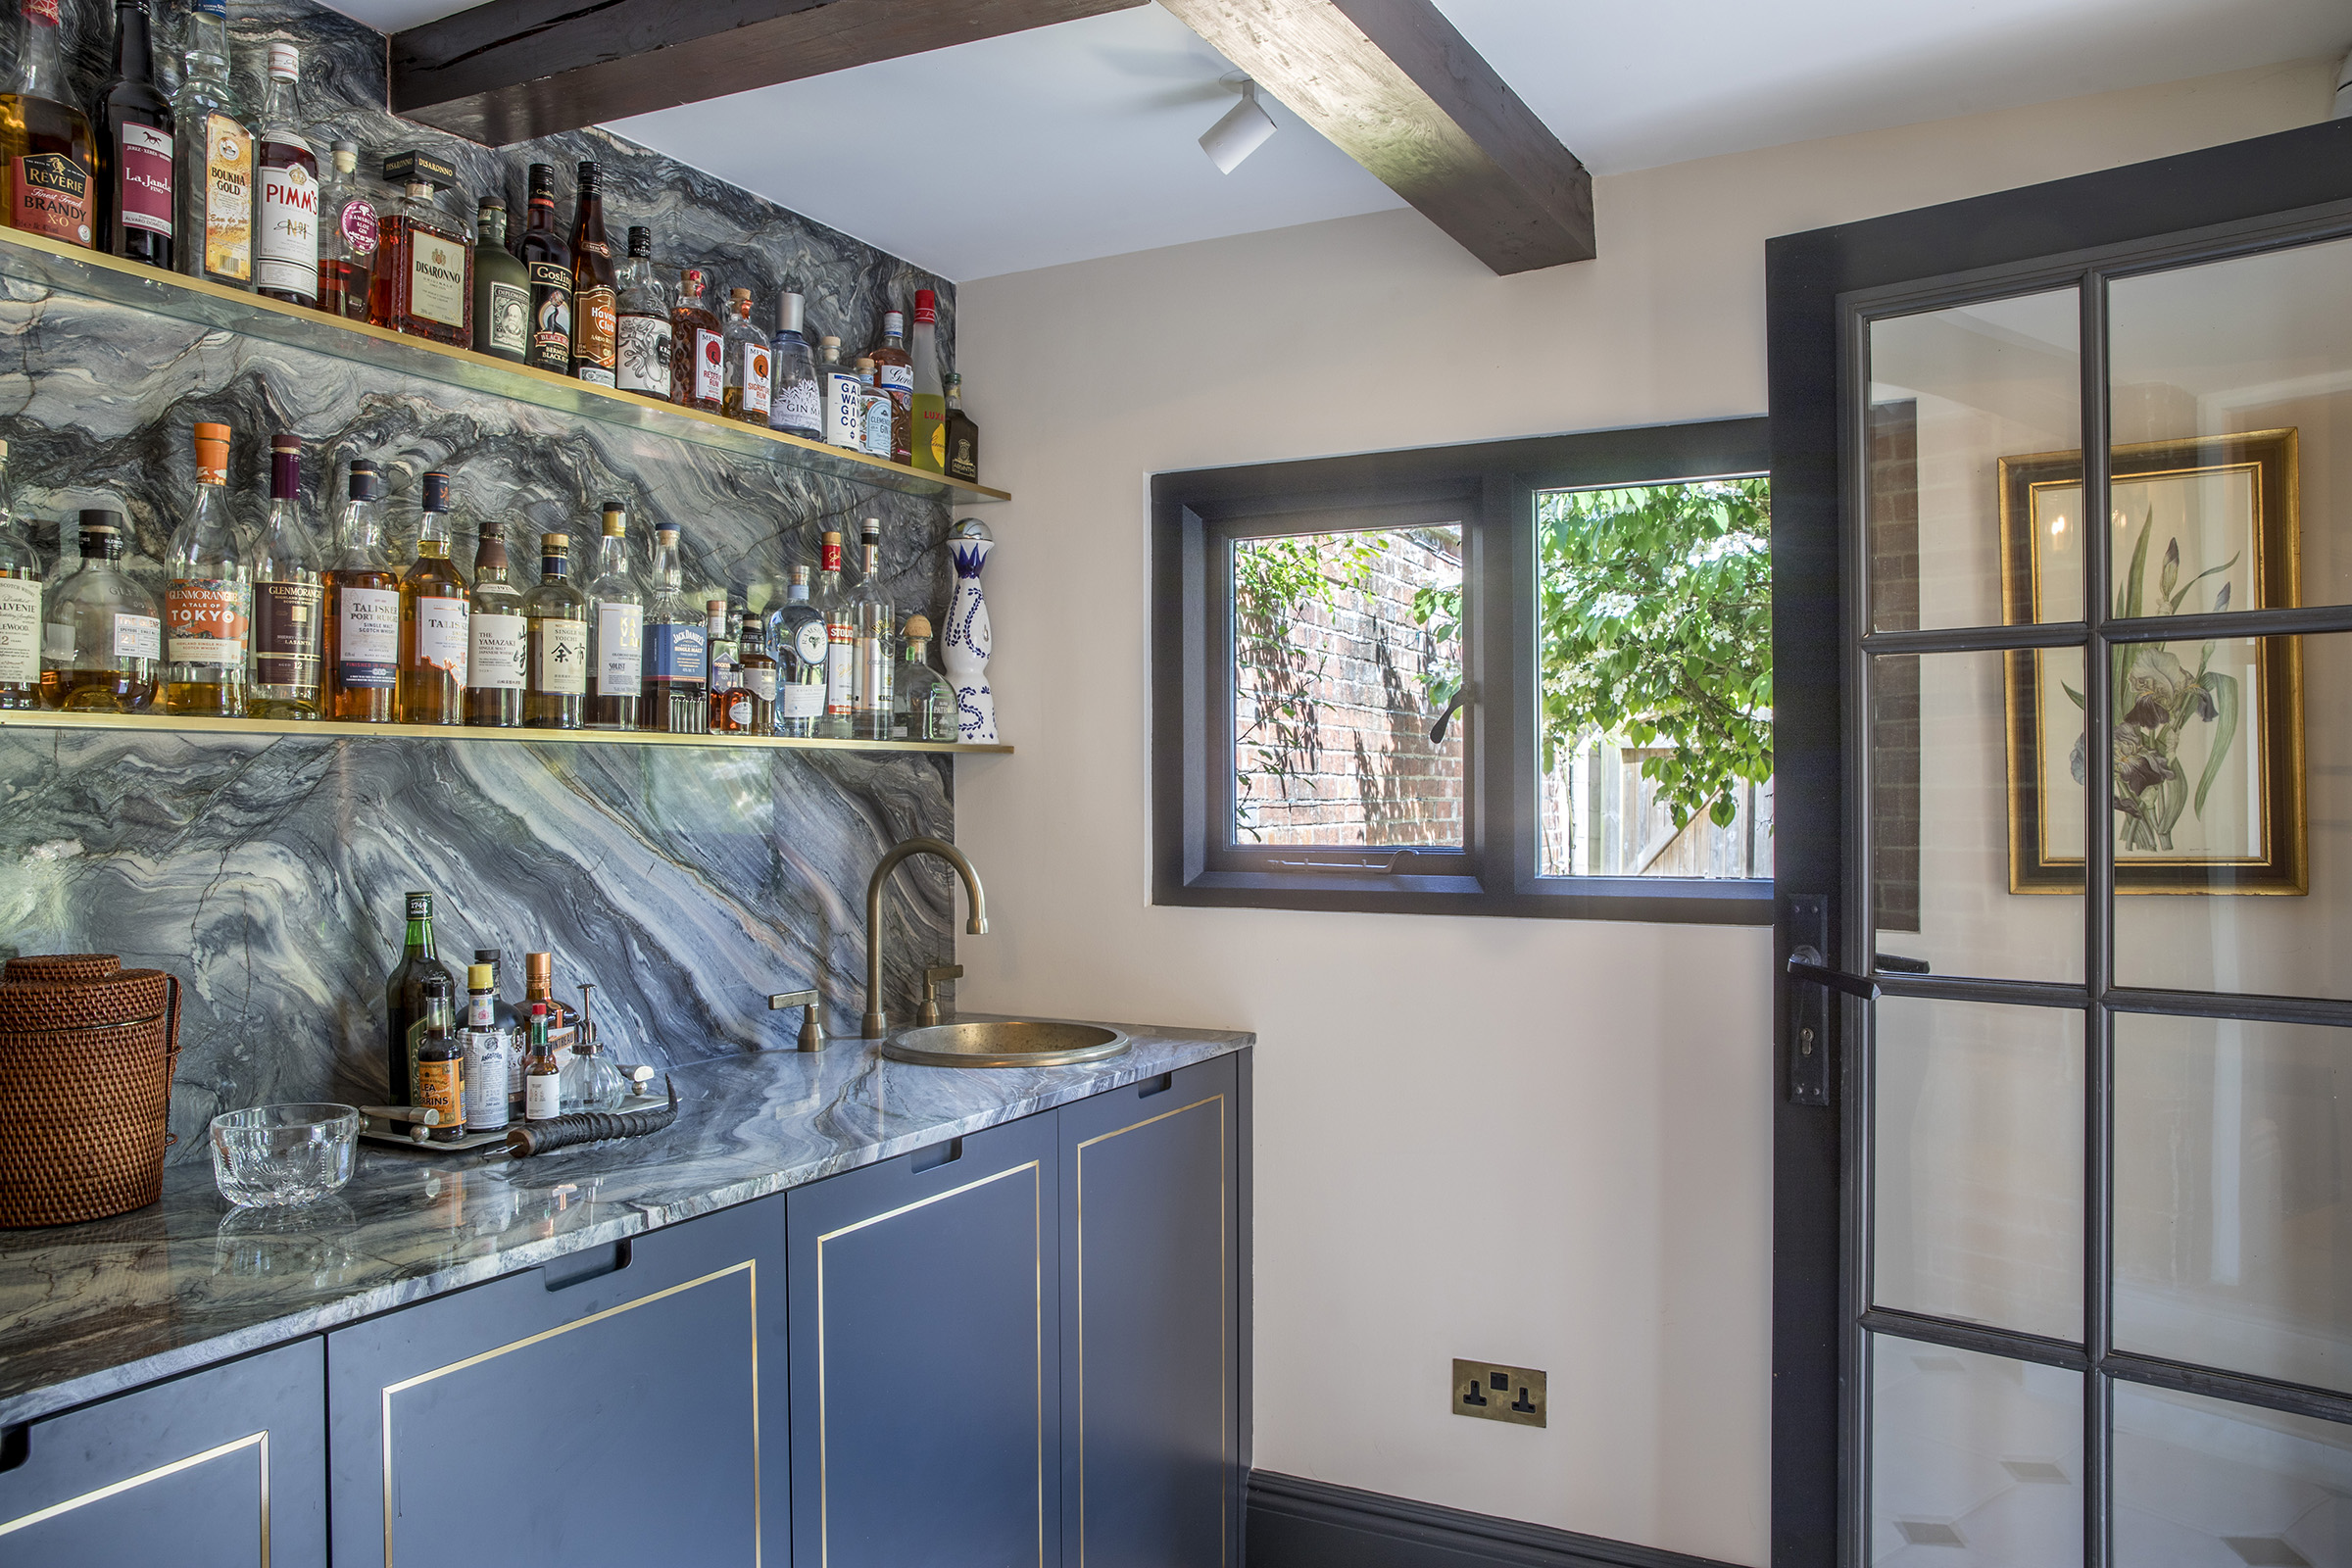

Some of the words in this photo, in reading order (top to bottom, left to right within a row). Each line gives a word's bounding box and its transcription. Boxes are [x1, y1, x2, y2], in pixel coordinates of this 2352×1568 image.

[418, 157, 454, 177] DISARONNO
[29, 168, 84, 194] RÊVERIE
[125, 167, 142, 183] La
[141, 174, 172, 193] Janda
[211, 167, 246, 187] BOUKHA
[30, 187, 59, 201] Finest
[217, 179, 241, 196] GOLD
[266, 183, 318, 216] PIMM'S
[24, 195, 87, 222] BRANDY
[416, 260, 461, 284] DISARONNO
[599, 318, 614, 333] Club
[786, 403, 808, 414] GIN
[169, 590, 238, 603] GLENMORANGIE
[119, 616, 137, 626] THE
[172, 609, 235, 624] TOKYO
[350, 612, 373, 621] PORT
[121, 634, 136, 645] 21
[478, 638, 516, 647] YAMAZAKI
[672, 631, 686, 645] JACK
[550, 641, 586, 665] 余市
[294, 661, 303, 670] 12
[420, 1083, 437, 1093] LEA
